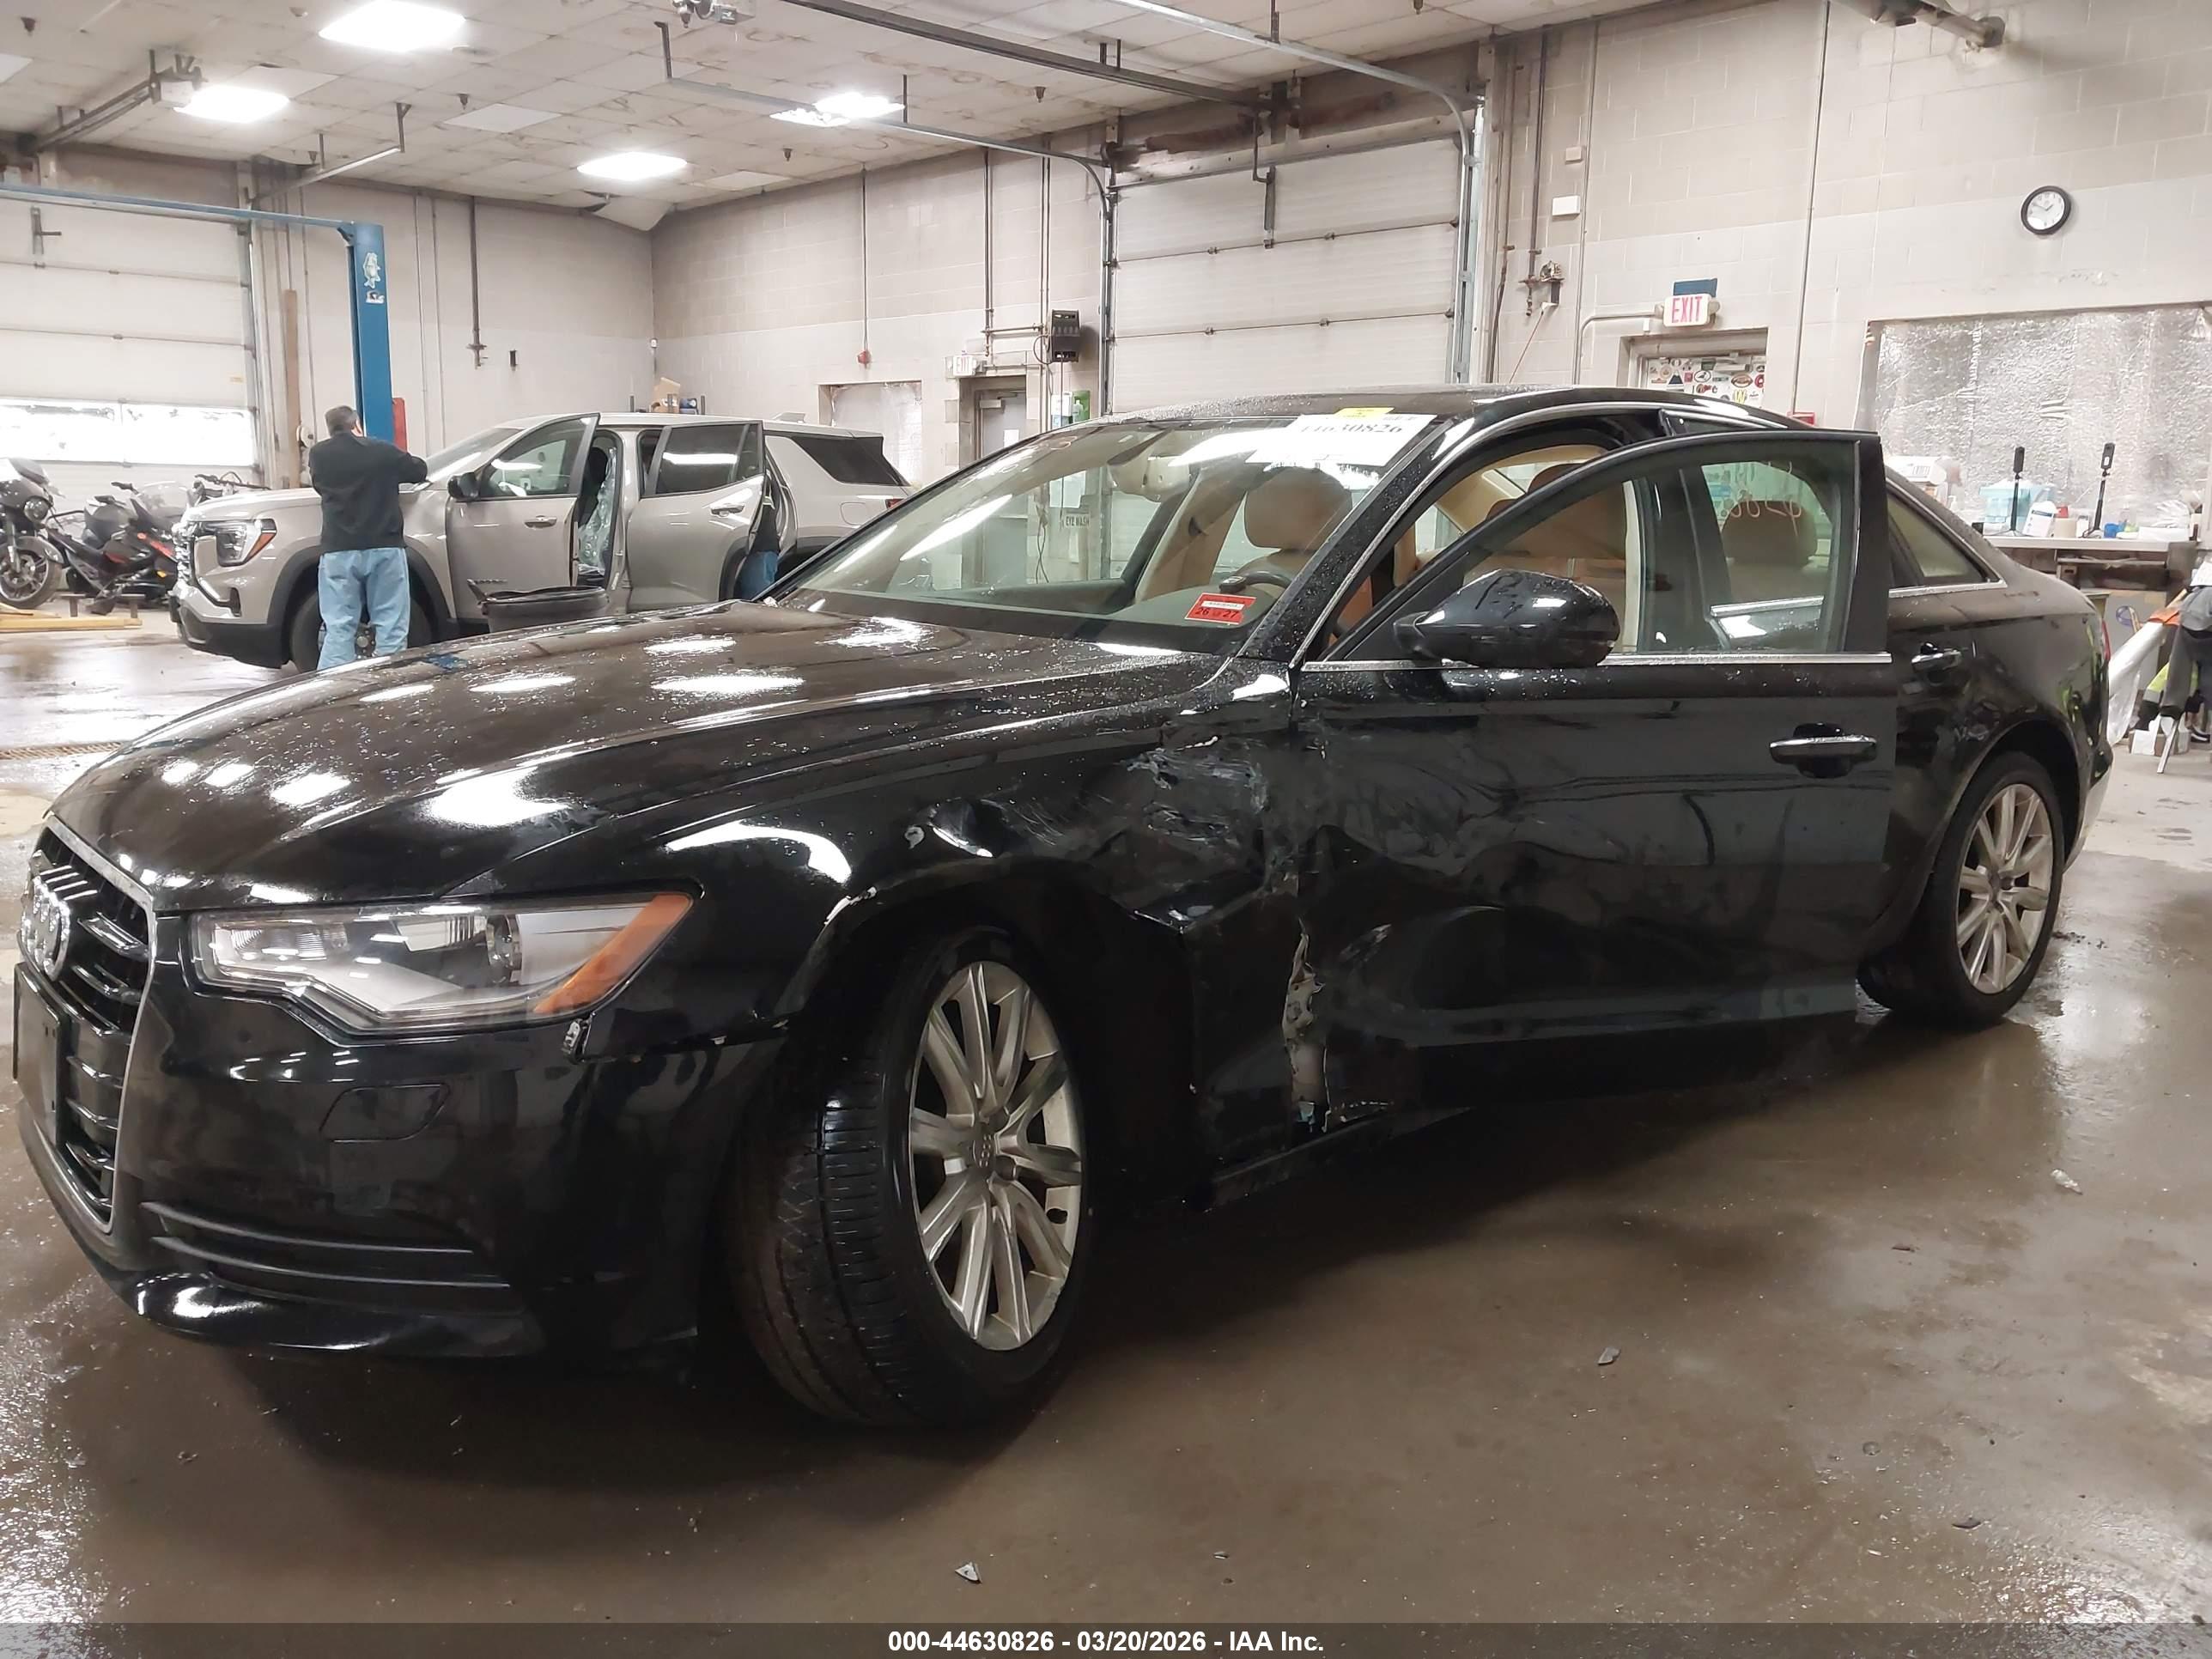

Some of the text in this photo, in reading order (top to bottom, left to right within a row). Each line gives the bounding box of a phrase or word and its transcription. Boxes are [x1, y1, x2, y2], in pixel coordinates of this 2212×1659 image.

[1671, 295, 1703, 324] EXIT
[1194, 607, 1210, 617] 26
[1222, 610, 1240, 619] 27
